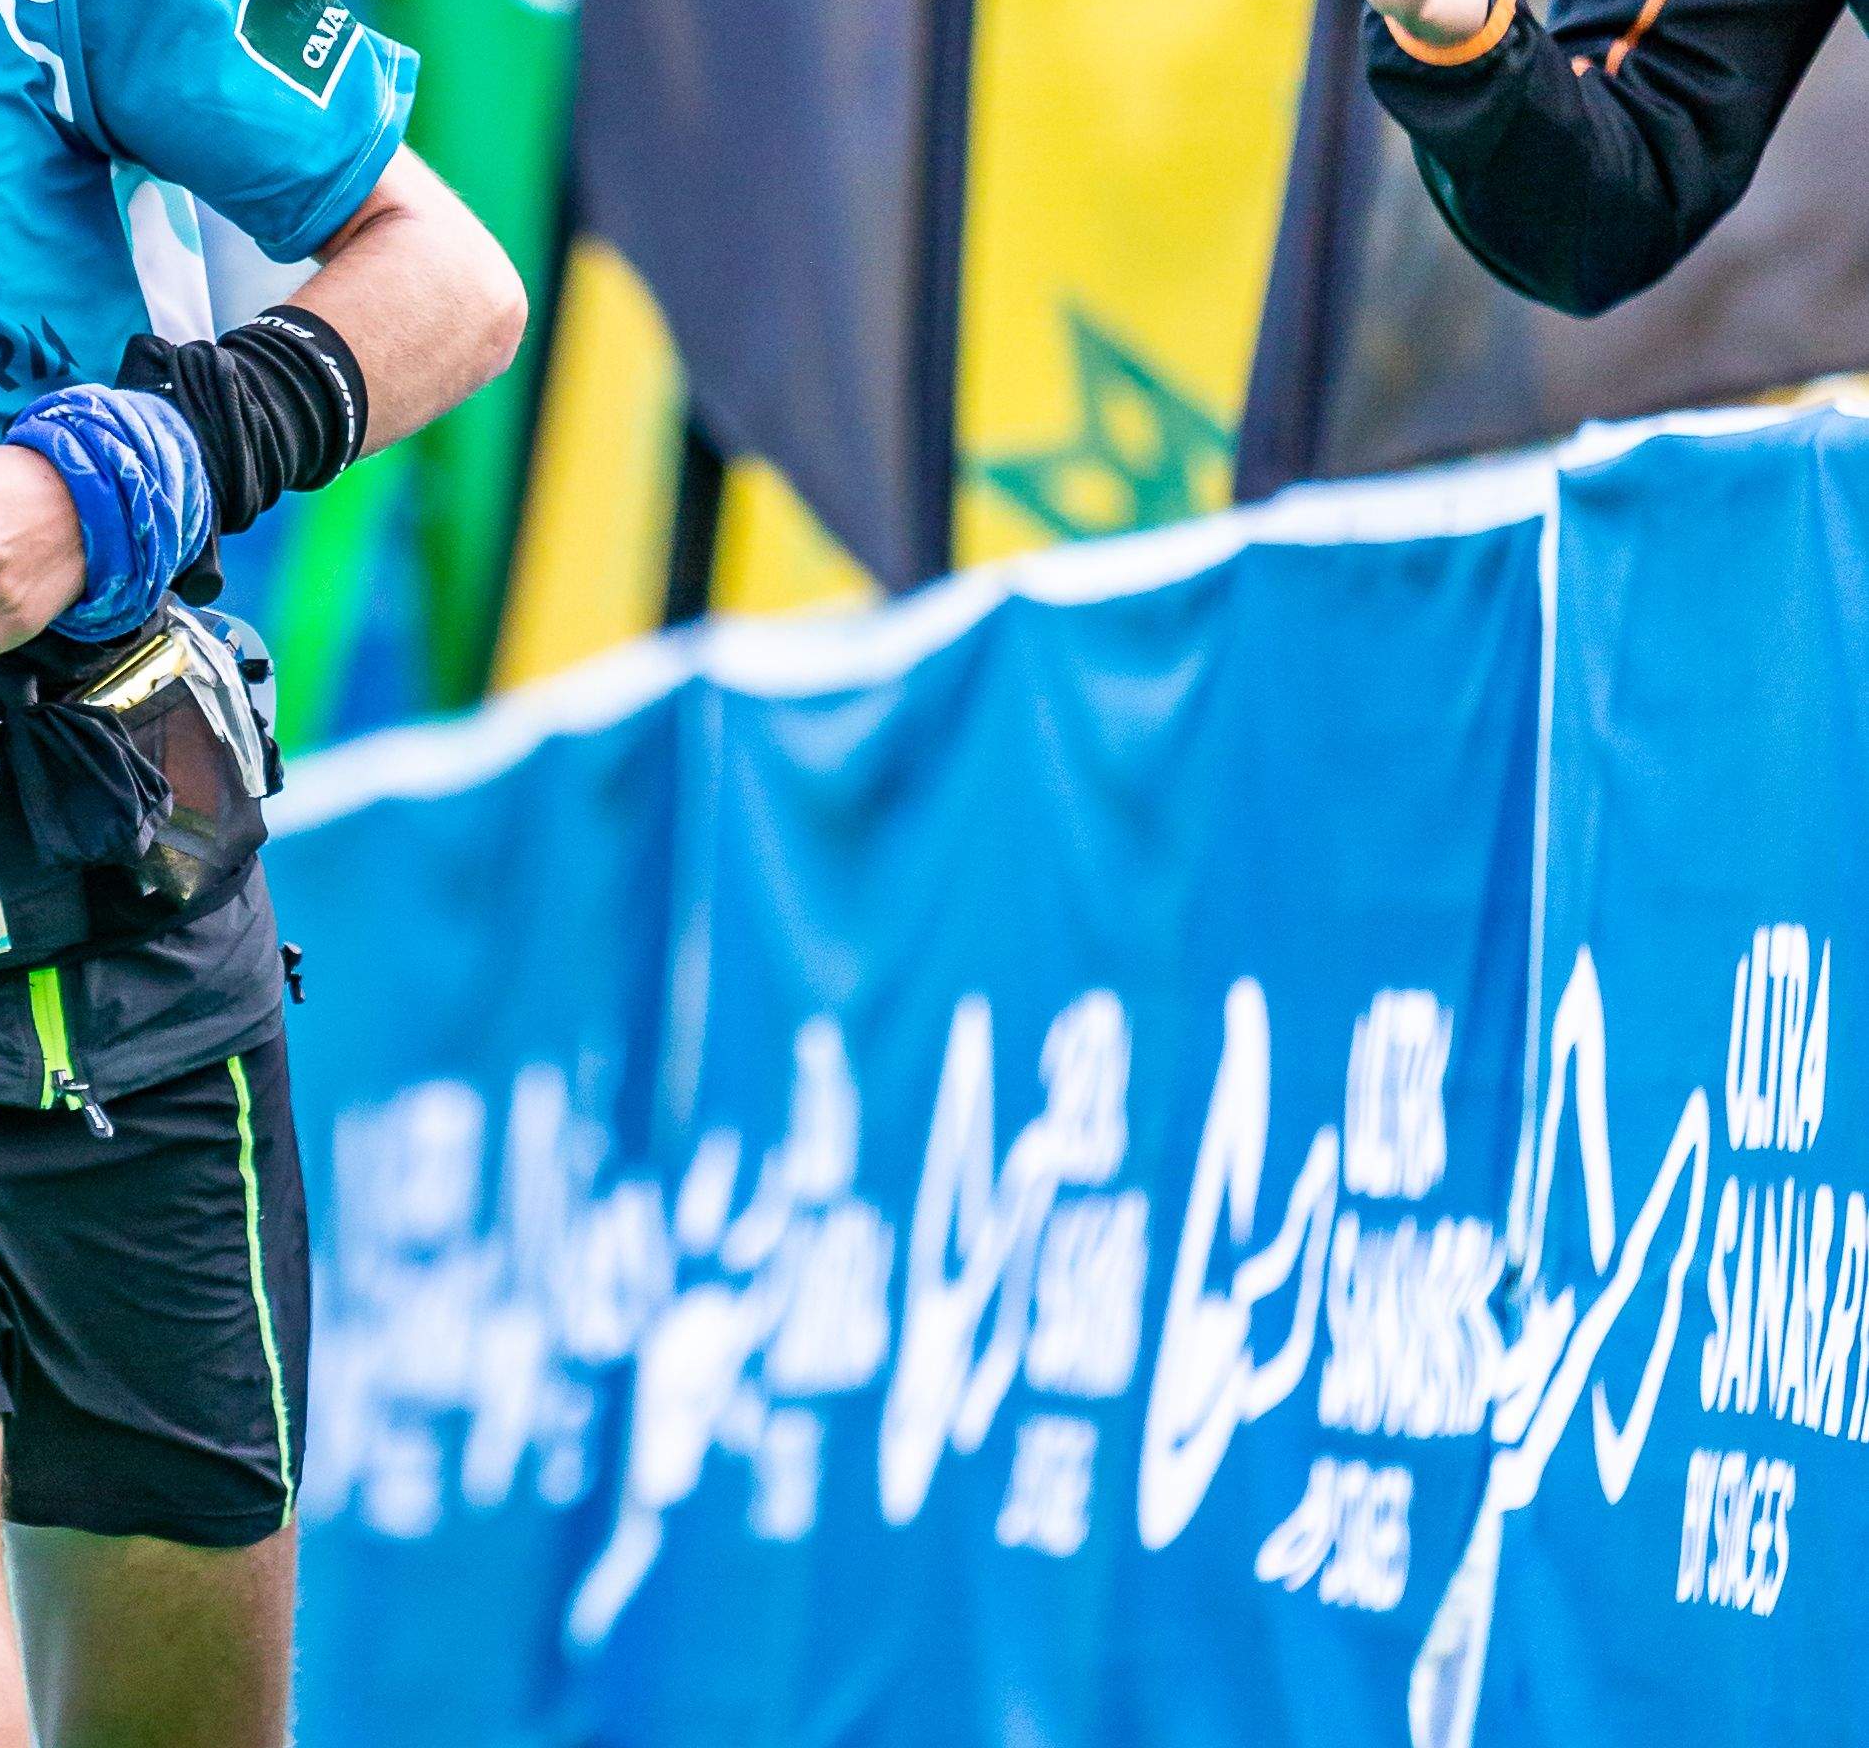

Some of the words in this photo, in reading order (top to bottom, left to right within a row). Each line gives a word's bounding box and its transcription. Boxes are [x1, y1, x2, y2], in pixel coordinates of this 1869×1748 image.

[302, 6, 350, 69] CAJA
[1725, 921, 1831, 1152] ULTRA
[1700, 1174, 1869, 1444] SANABRI
